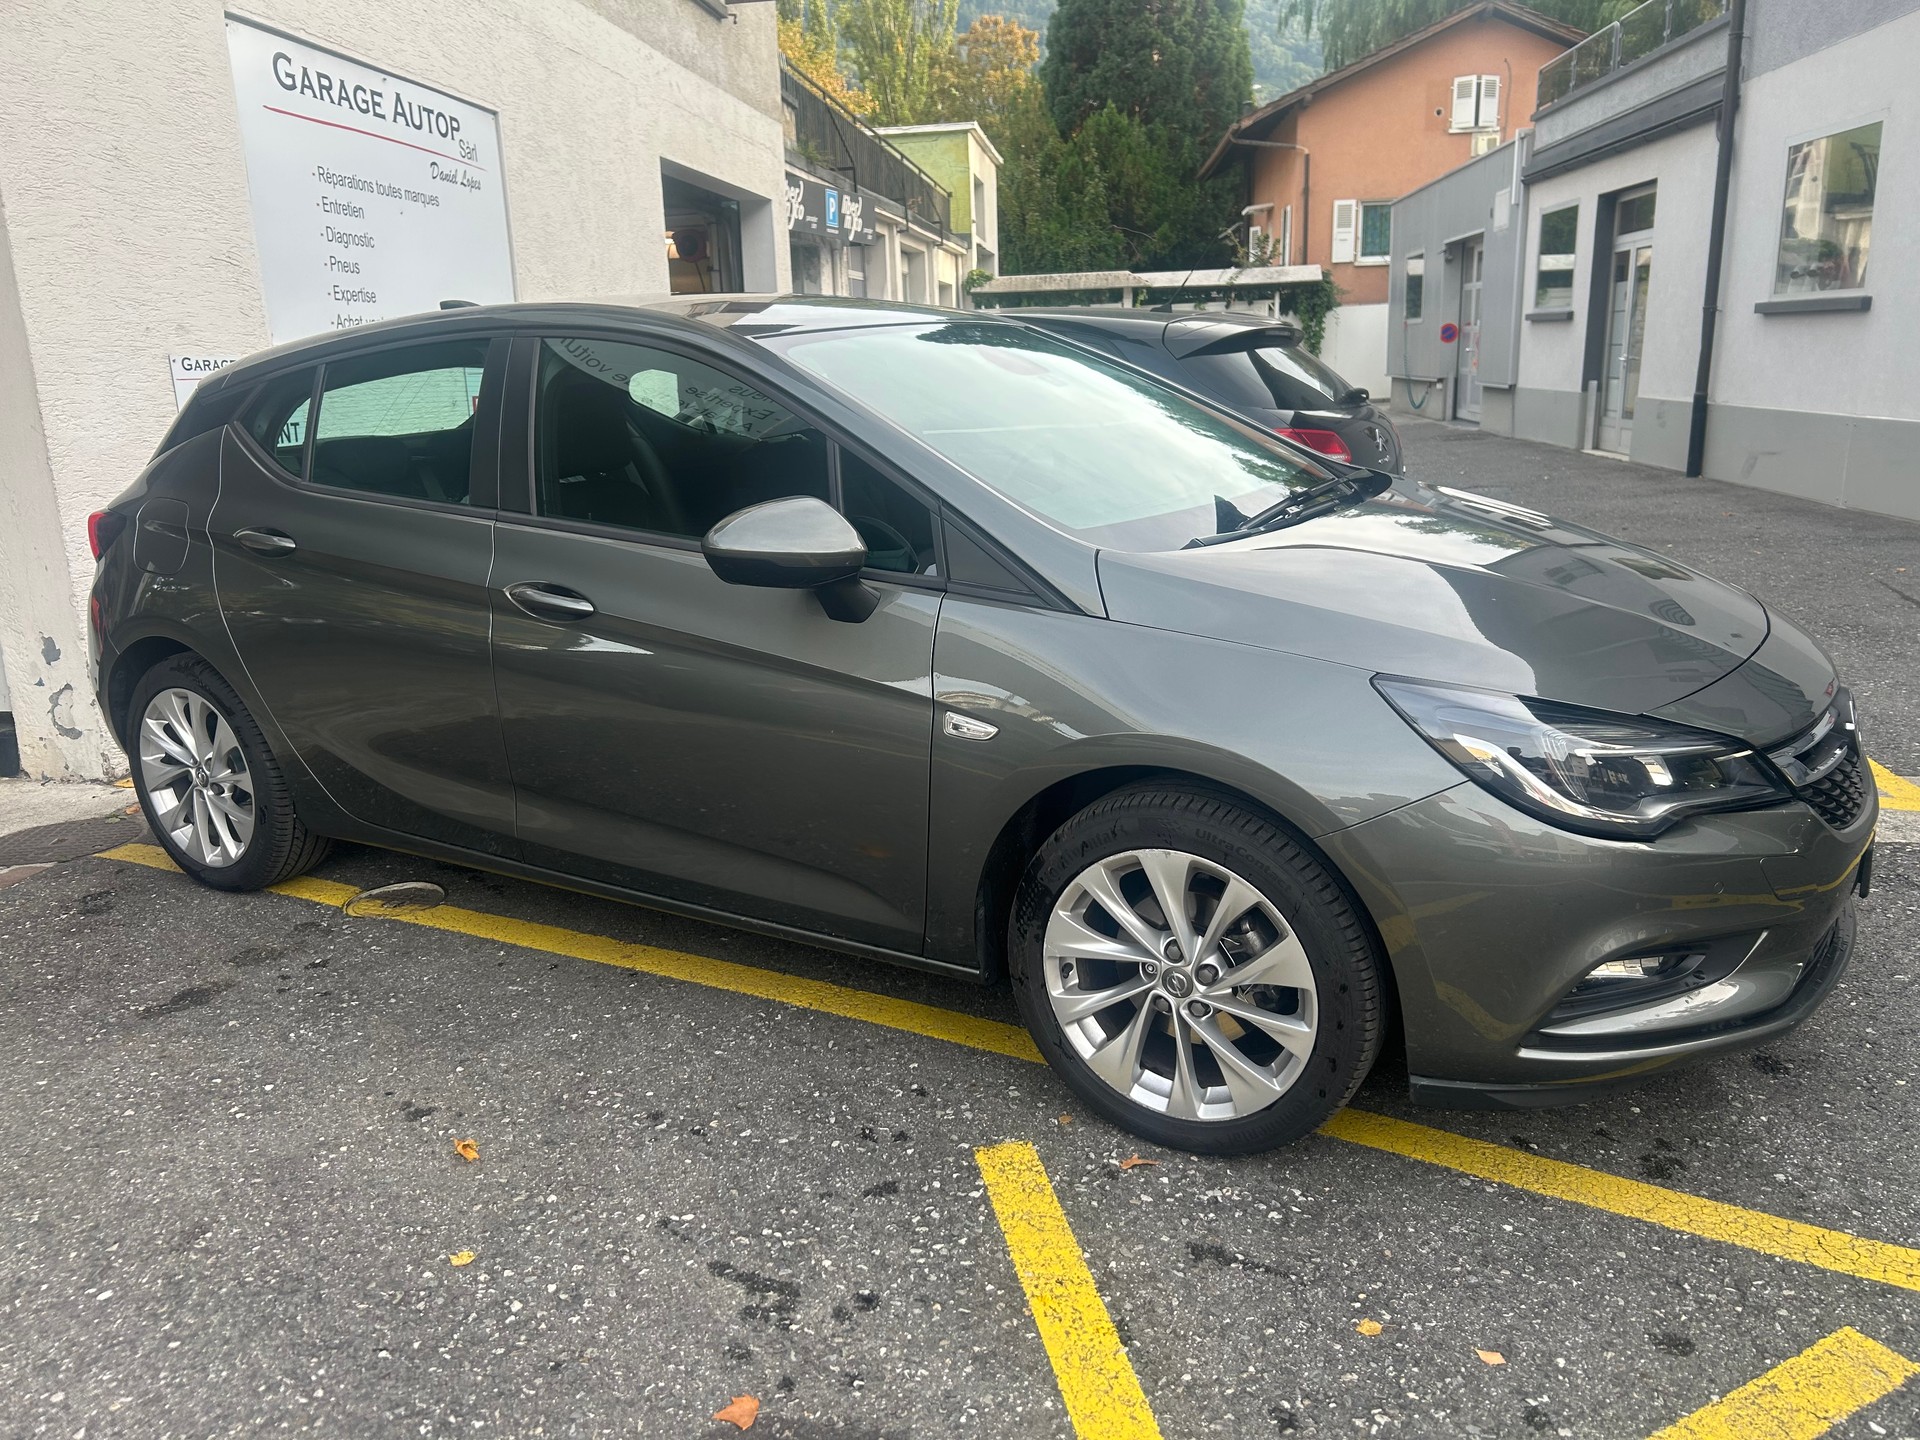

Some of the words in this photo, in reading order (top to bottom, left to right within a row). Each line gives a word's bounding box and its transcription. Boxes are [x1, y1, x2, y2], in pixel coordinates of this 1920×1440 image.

[272, 51, 387, 121] GARAGE
[392, 91, 461, 141] AUTOP
[317, 165, 375, 195] Réparations
[375, 179, 403, 201] toutes
[404, 188, 440, 209] marques
[429, 161, 459, 185] Daniel
[460, 169, 482, 193] Lopes
[321, 195, 365, 220] Entretien
[828, 197, 837, 220] P
[325, 226, 376, 249] Diagnostic
[329, 255, 361, 275] Pneus
[332, 284, 377, 306] Expertise
[181, 356, 236, 371] GARAG
